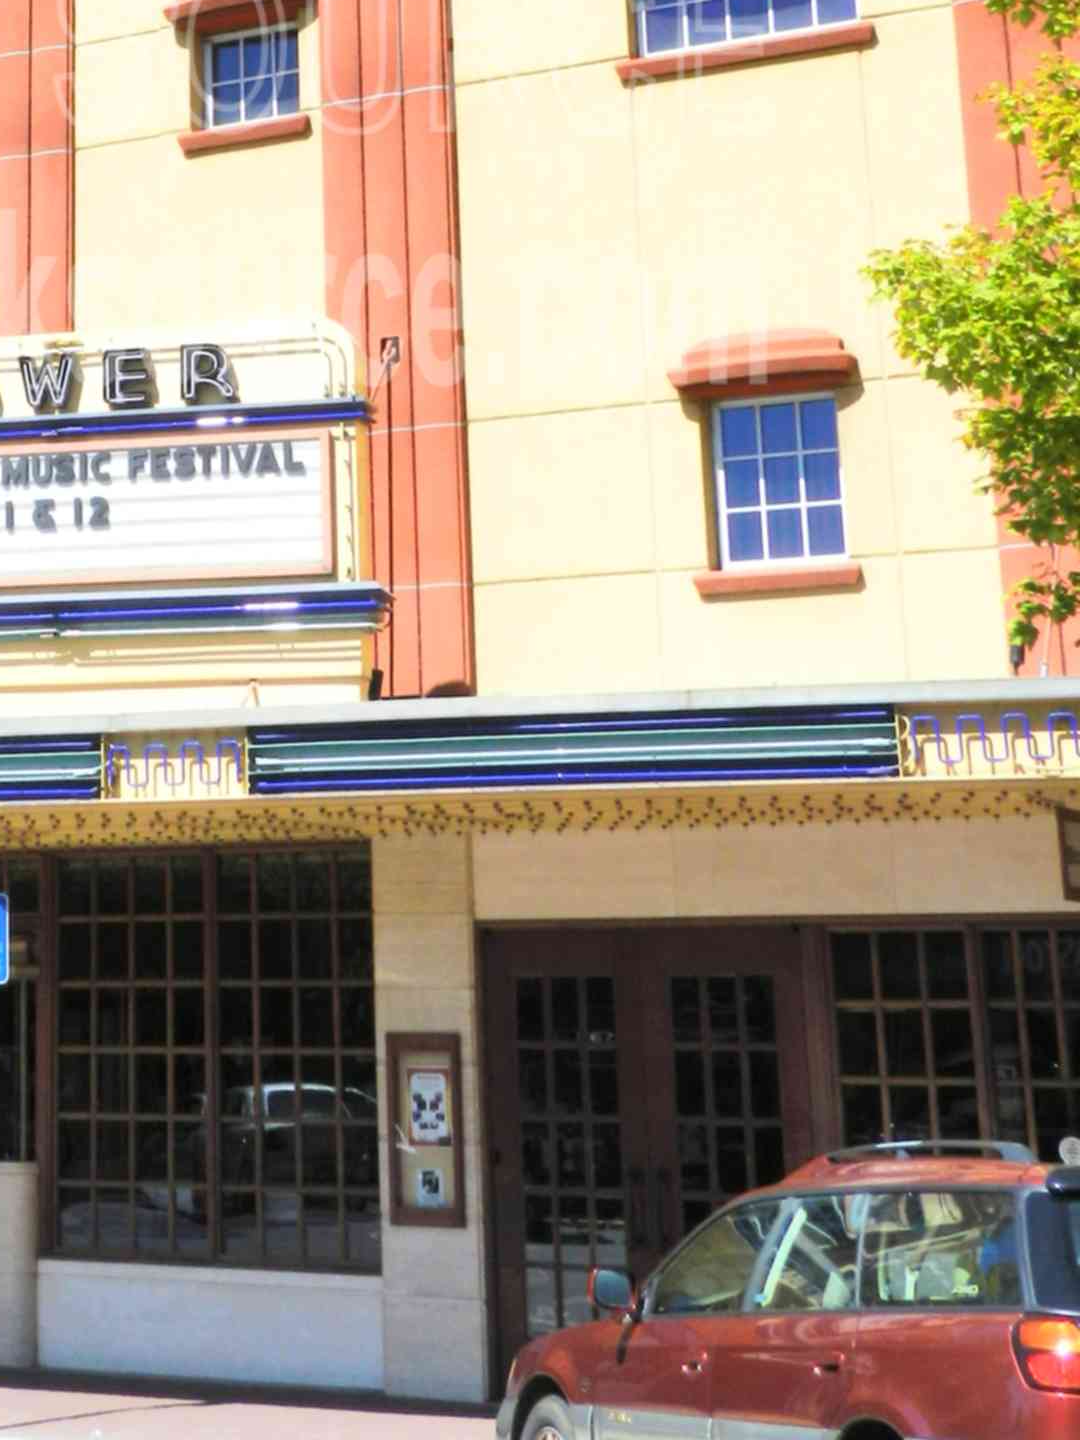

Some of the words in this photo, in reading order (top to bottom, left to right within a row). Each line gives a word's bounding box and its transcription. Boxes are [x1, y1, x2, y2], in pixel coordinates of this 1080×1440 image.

[1, 447, 112, 488] MUSIC
[127, 440, 307, 480] FESTIVAL
[32, 498, 57, 532] &
[73, 496, 111, 531] 12
